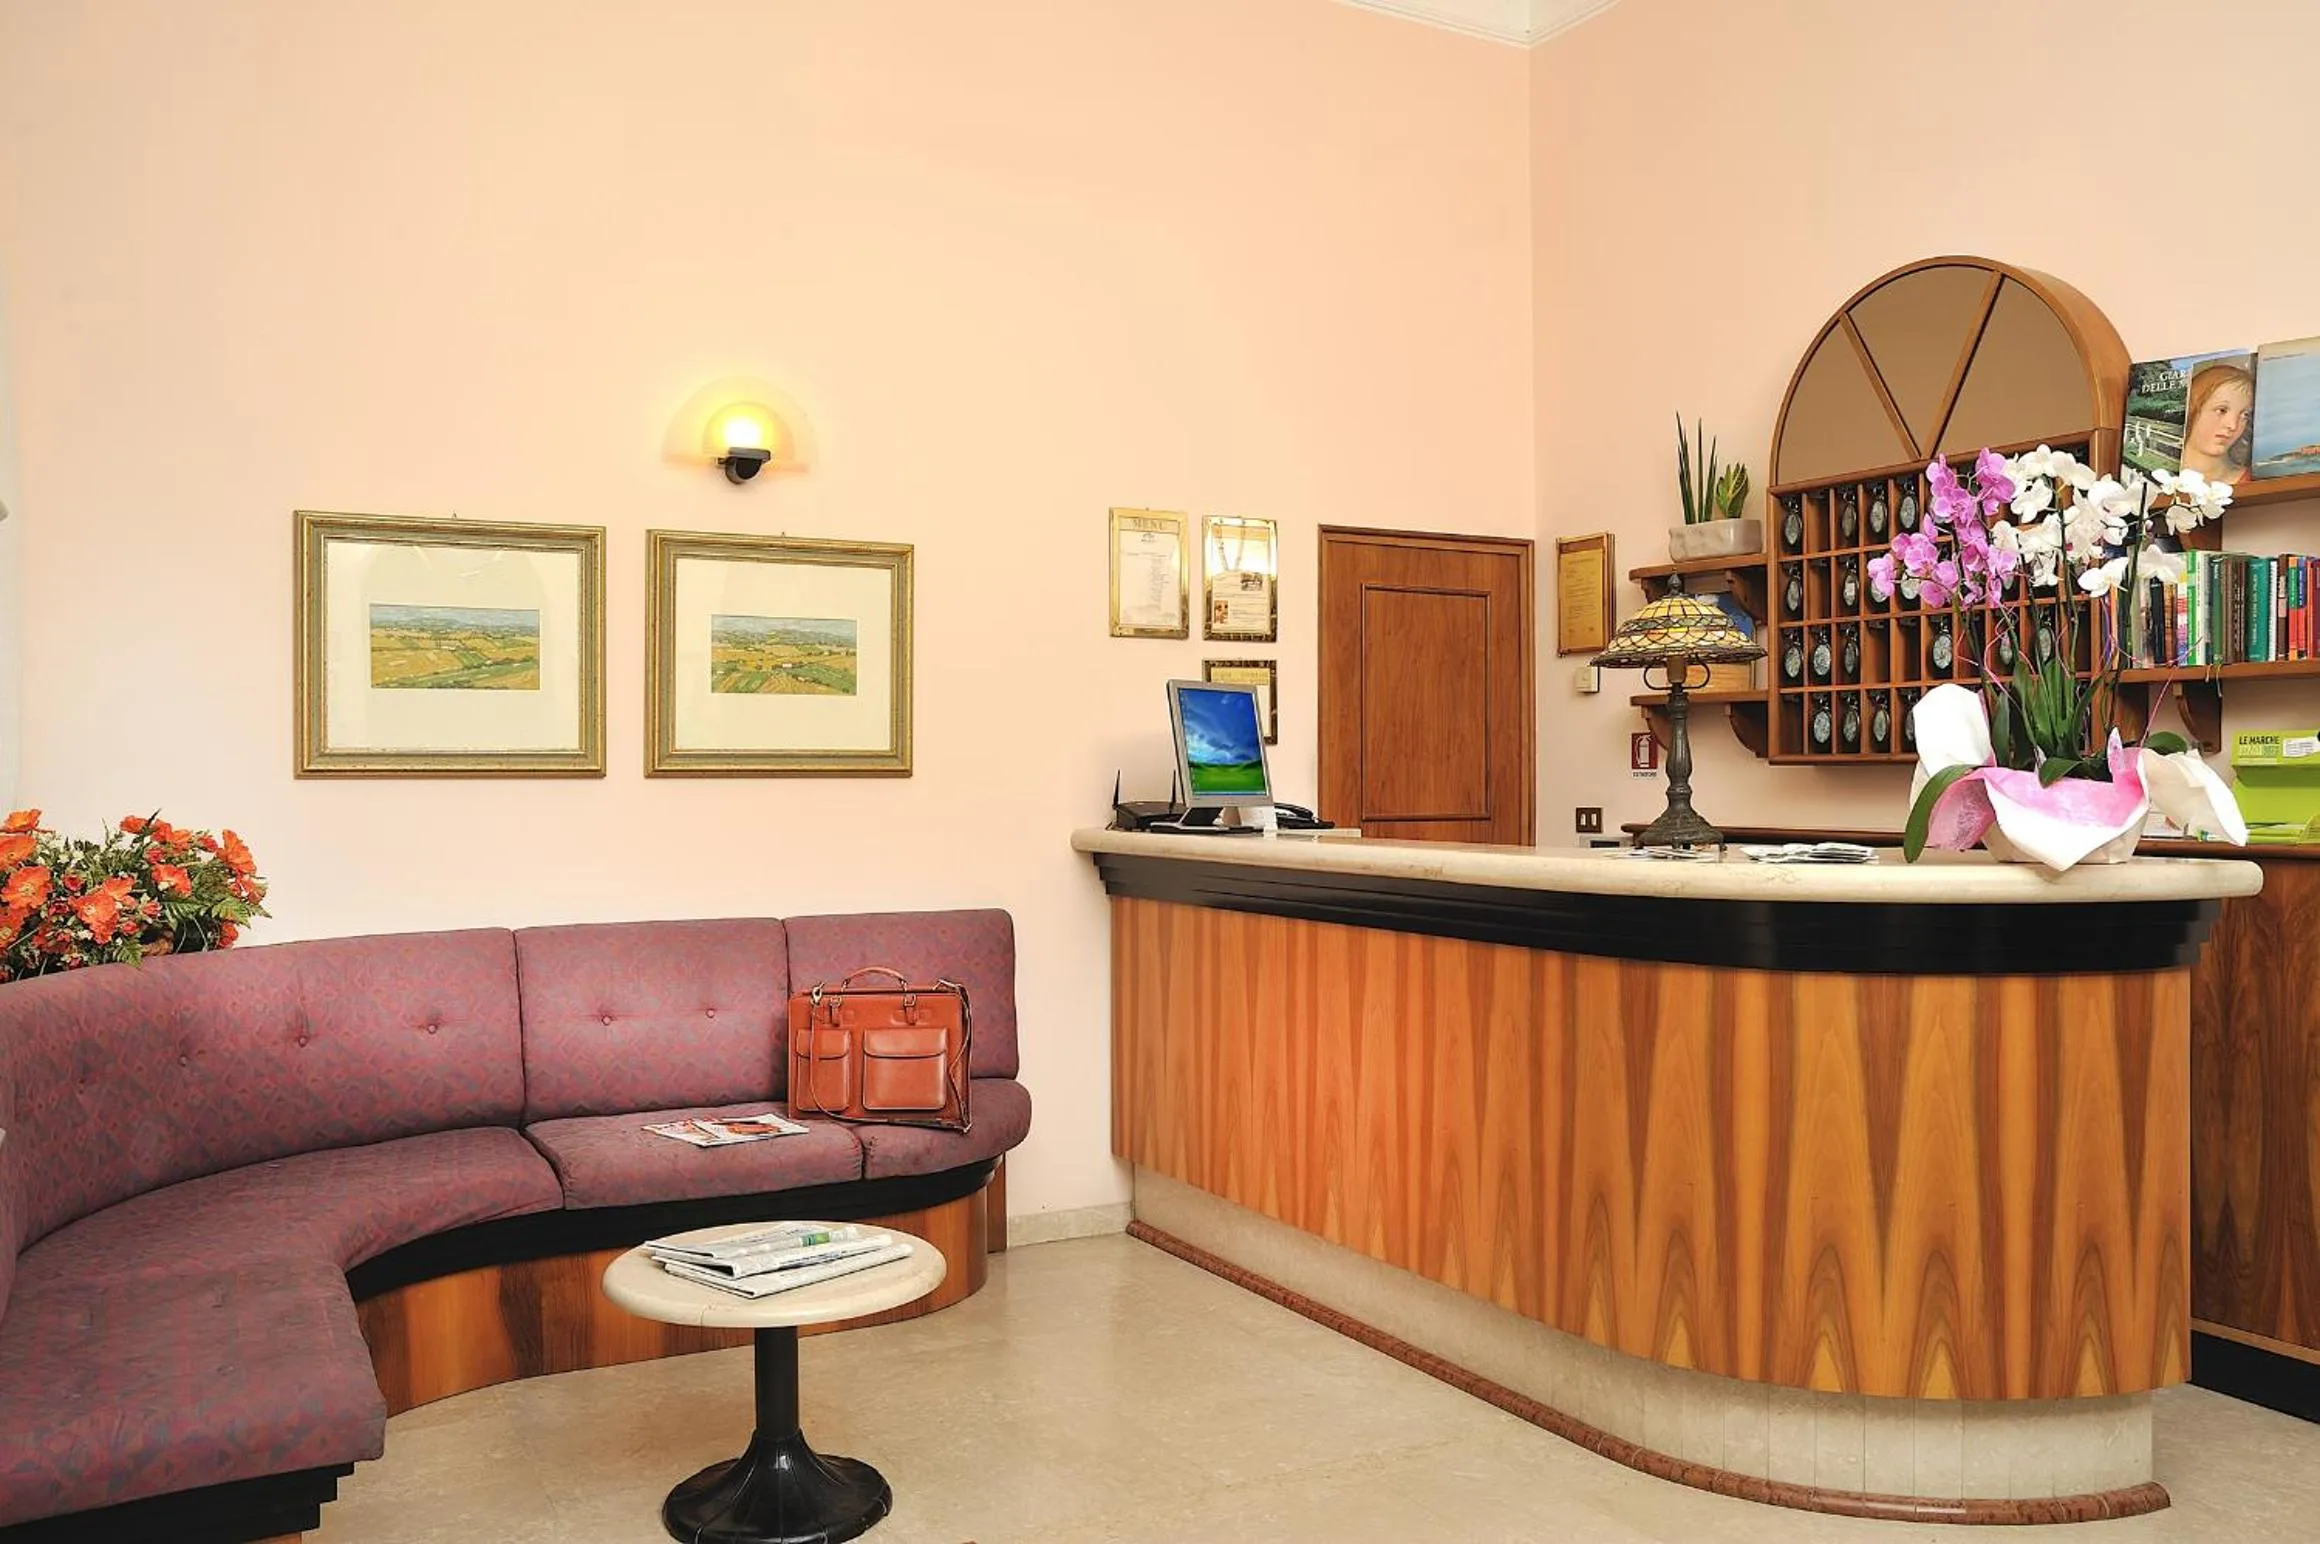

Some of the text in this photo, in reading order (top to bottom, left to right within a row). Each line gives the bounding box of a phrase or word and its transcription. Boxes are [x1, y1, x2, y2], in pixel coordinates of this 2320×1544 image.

[2141, 381, 2177, 393] DELLE
[2238, 735, 2280, 745] LE MARCHE
